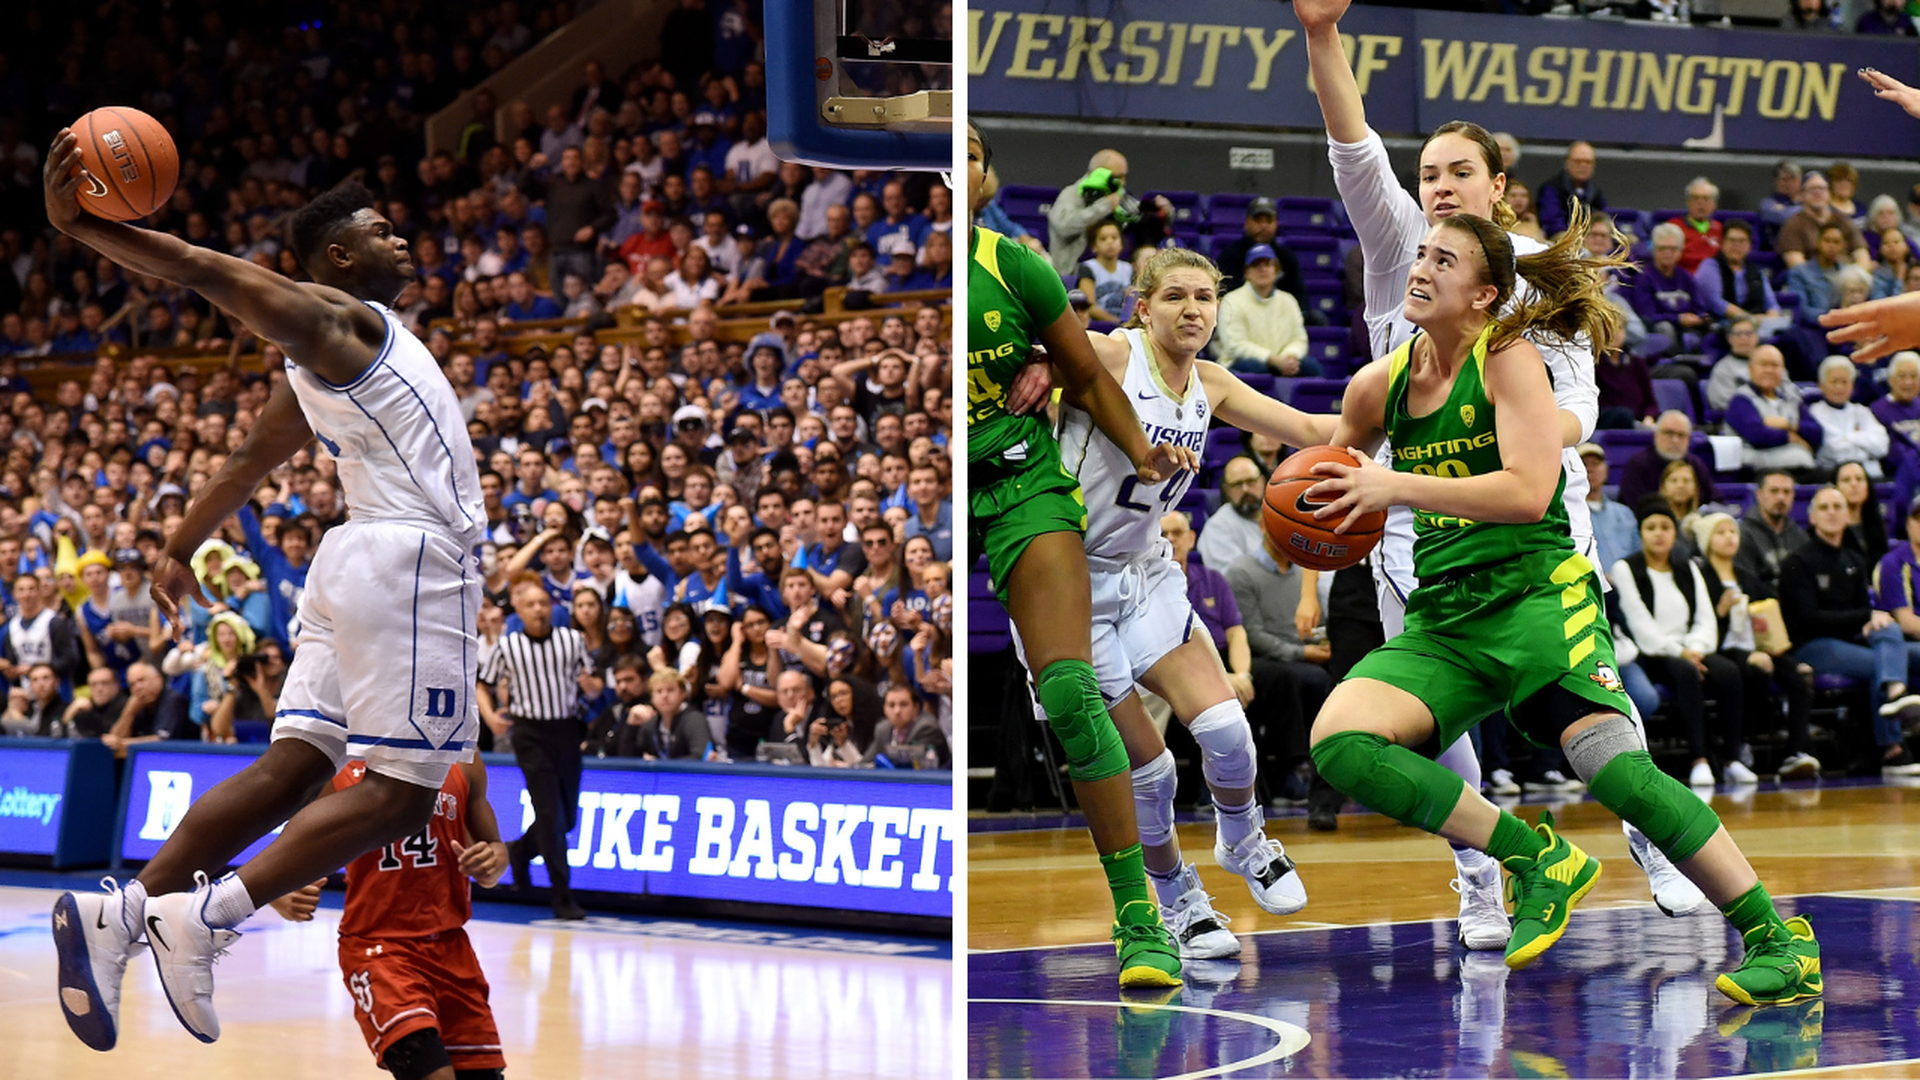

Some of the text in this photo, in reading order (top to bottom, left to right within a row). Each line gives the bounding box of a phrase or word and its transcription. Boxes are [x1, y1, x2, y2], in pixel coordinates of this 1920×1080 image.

[968, 9, 1296, 91] VERSITY
[1421, 38, 1847, 121] WASHINGTON
[102, 130, 139, 184] ELITE
[1289, 532, 1348, 557] ELITE
[424, 686, 456, 718] D
[0, 786, 61, 827] ottery
